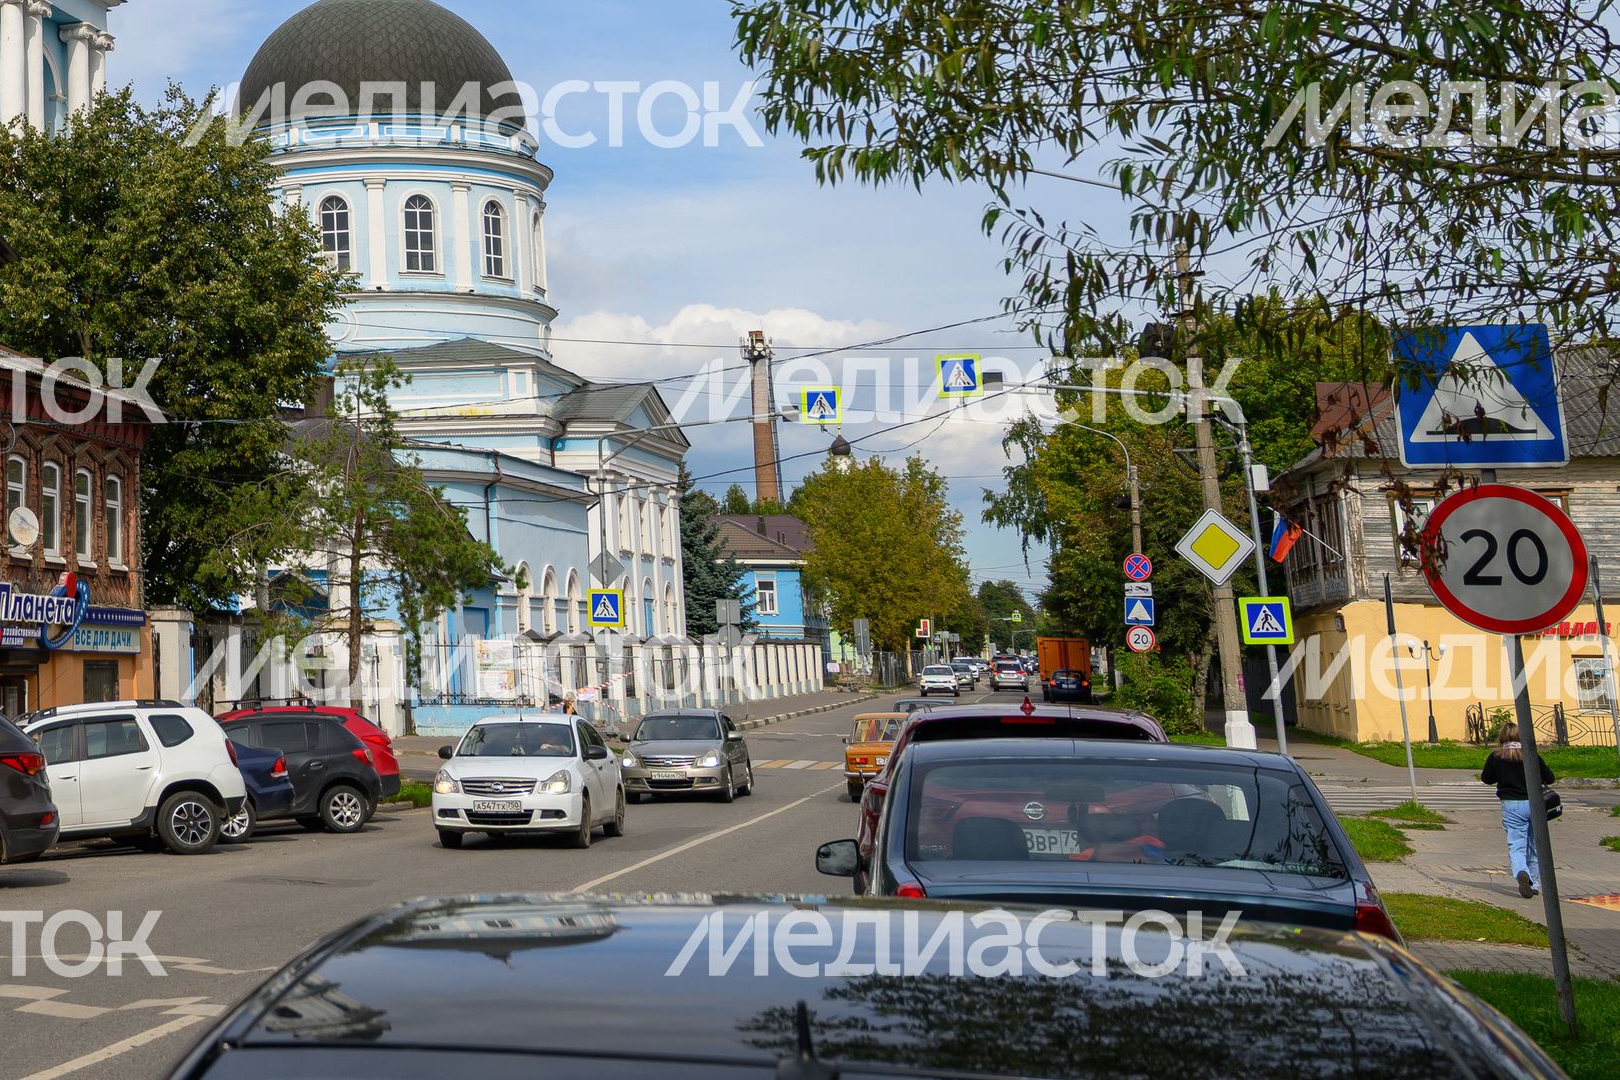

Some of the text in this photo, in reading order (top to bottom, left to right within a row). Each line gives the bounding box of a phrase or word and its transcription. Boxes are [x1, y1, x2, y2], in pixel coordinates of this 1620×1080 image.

[1459, 528, 1549, 586] 20
[75, 629, 132, 650] ВСЕ ДЛЯ ДАЧИ
[1133, 633, 1149, 645] 20
